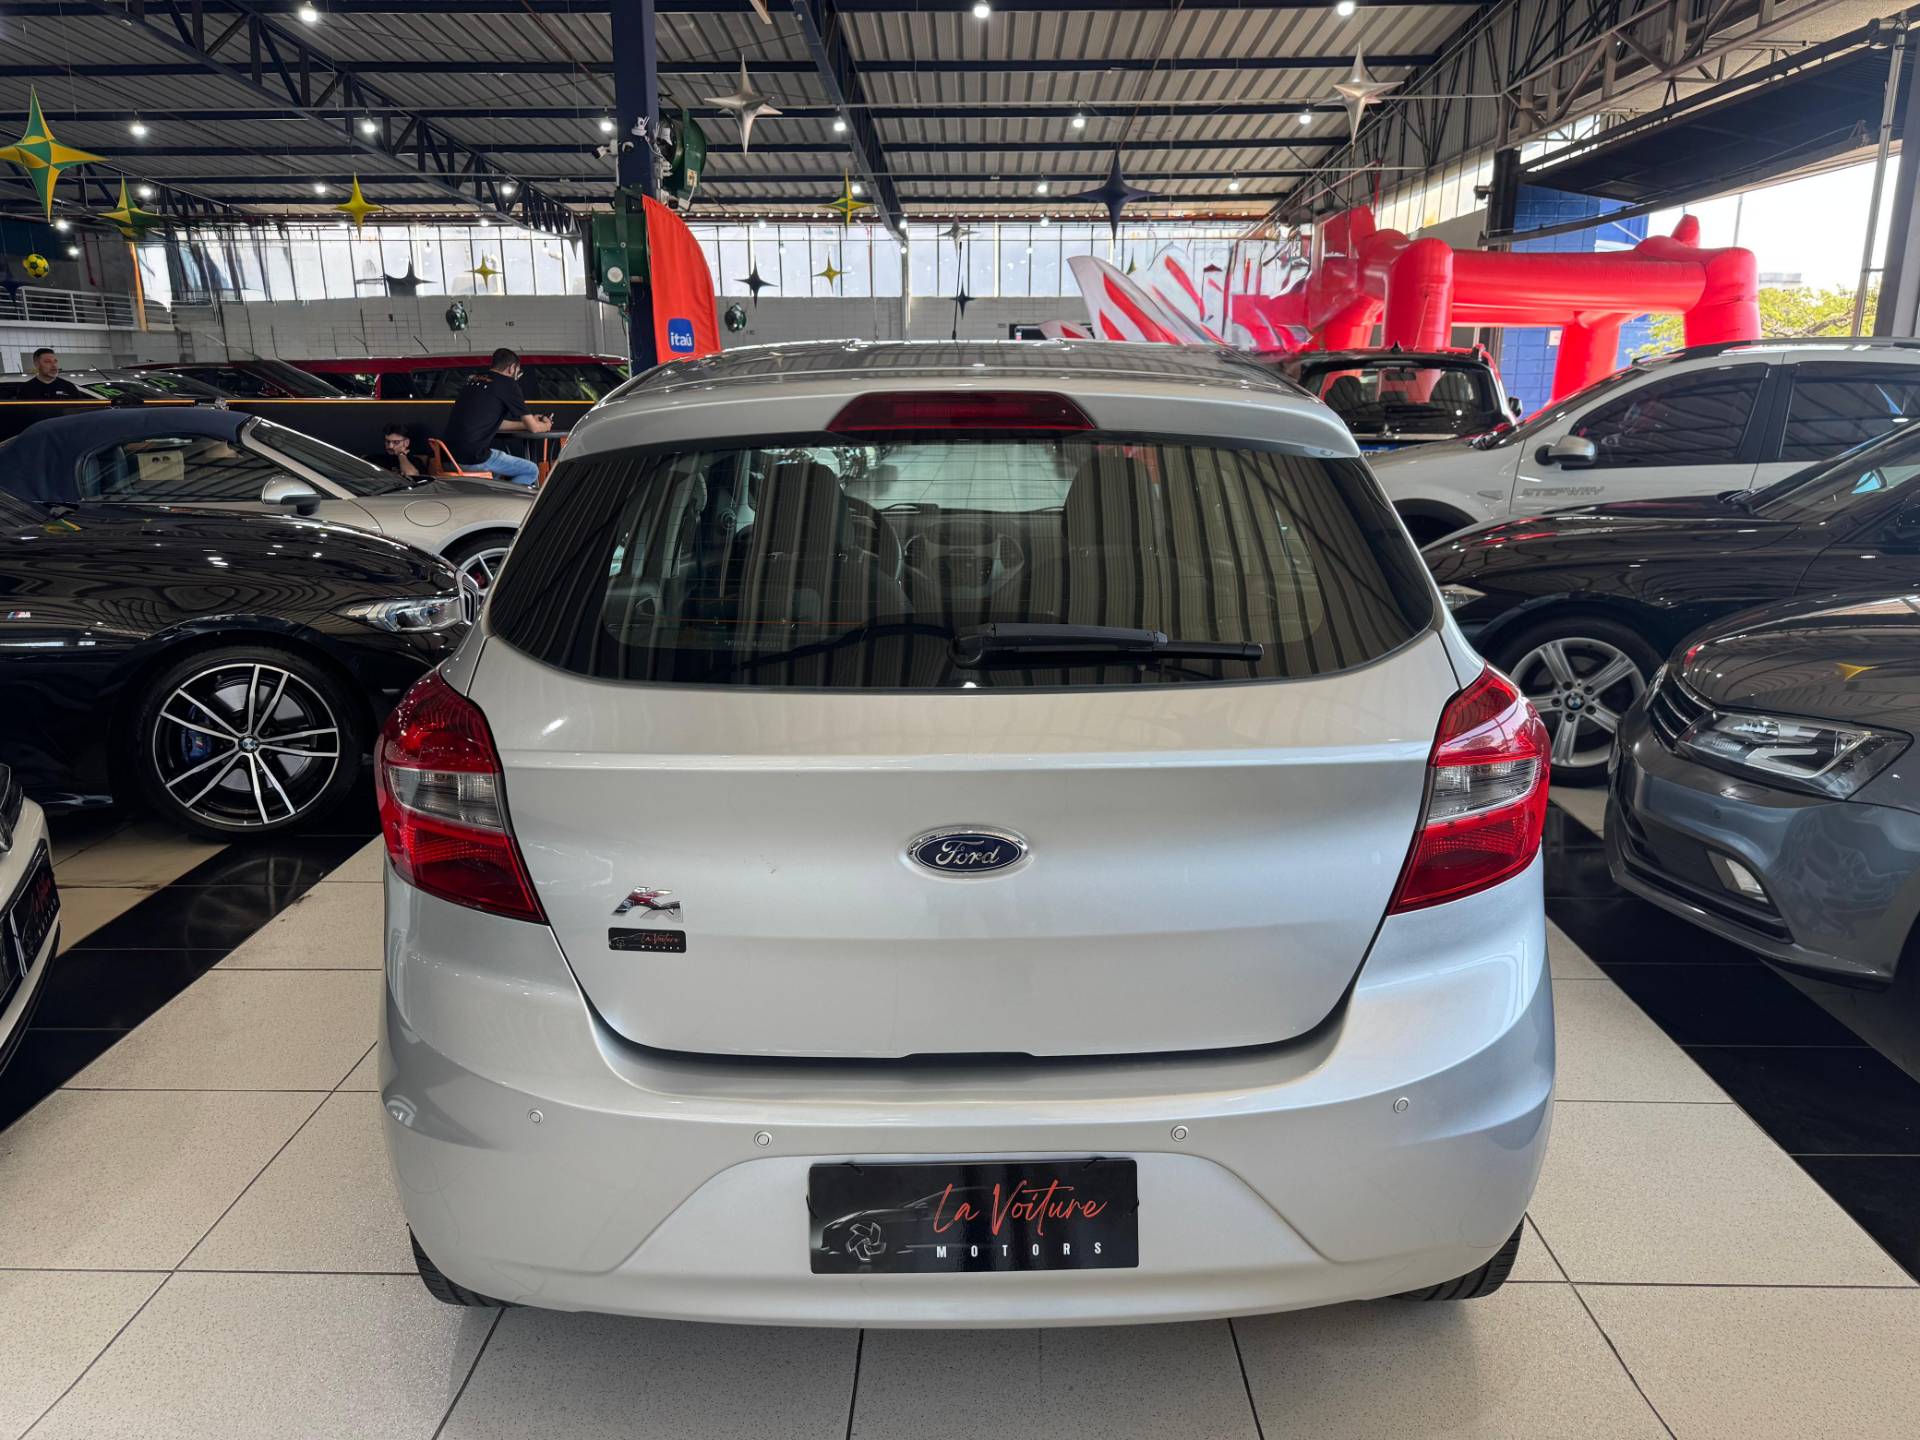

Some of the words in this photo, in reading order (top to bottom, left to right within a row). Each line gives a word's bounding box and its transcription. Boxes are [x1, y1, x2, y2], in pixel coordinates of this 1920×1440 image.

[935, 840, 1001, 865] Ford
[933, 1183, 980, 1233] La
[991, 1179, 1109, 1236] Voiture
[936, 1242, 1102, 1258] MOTORS
